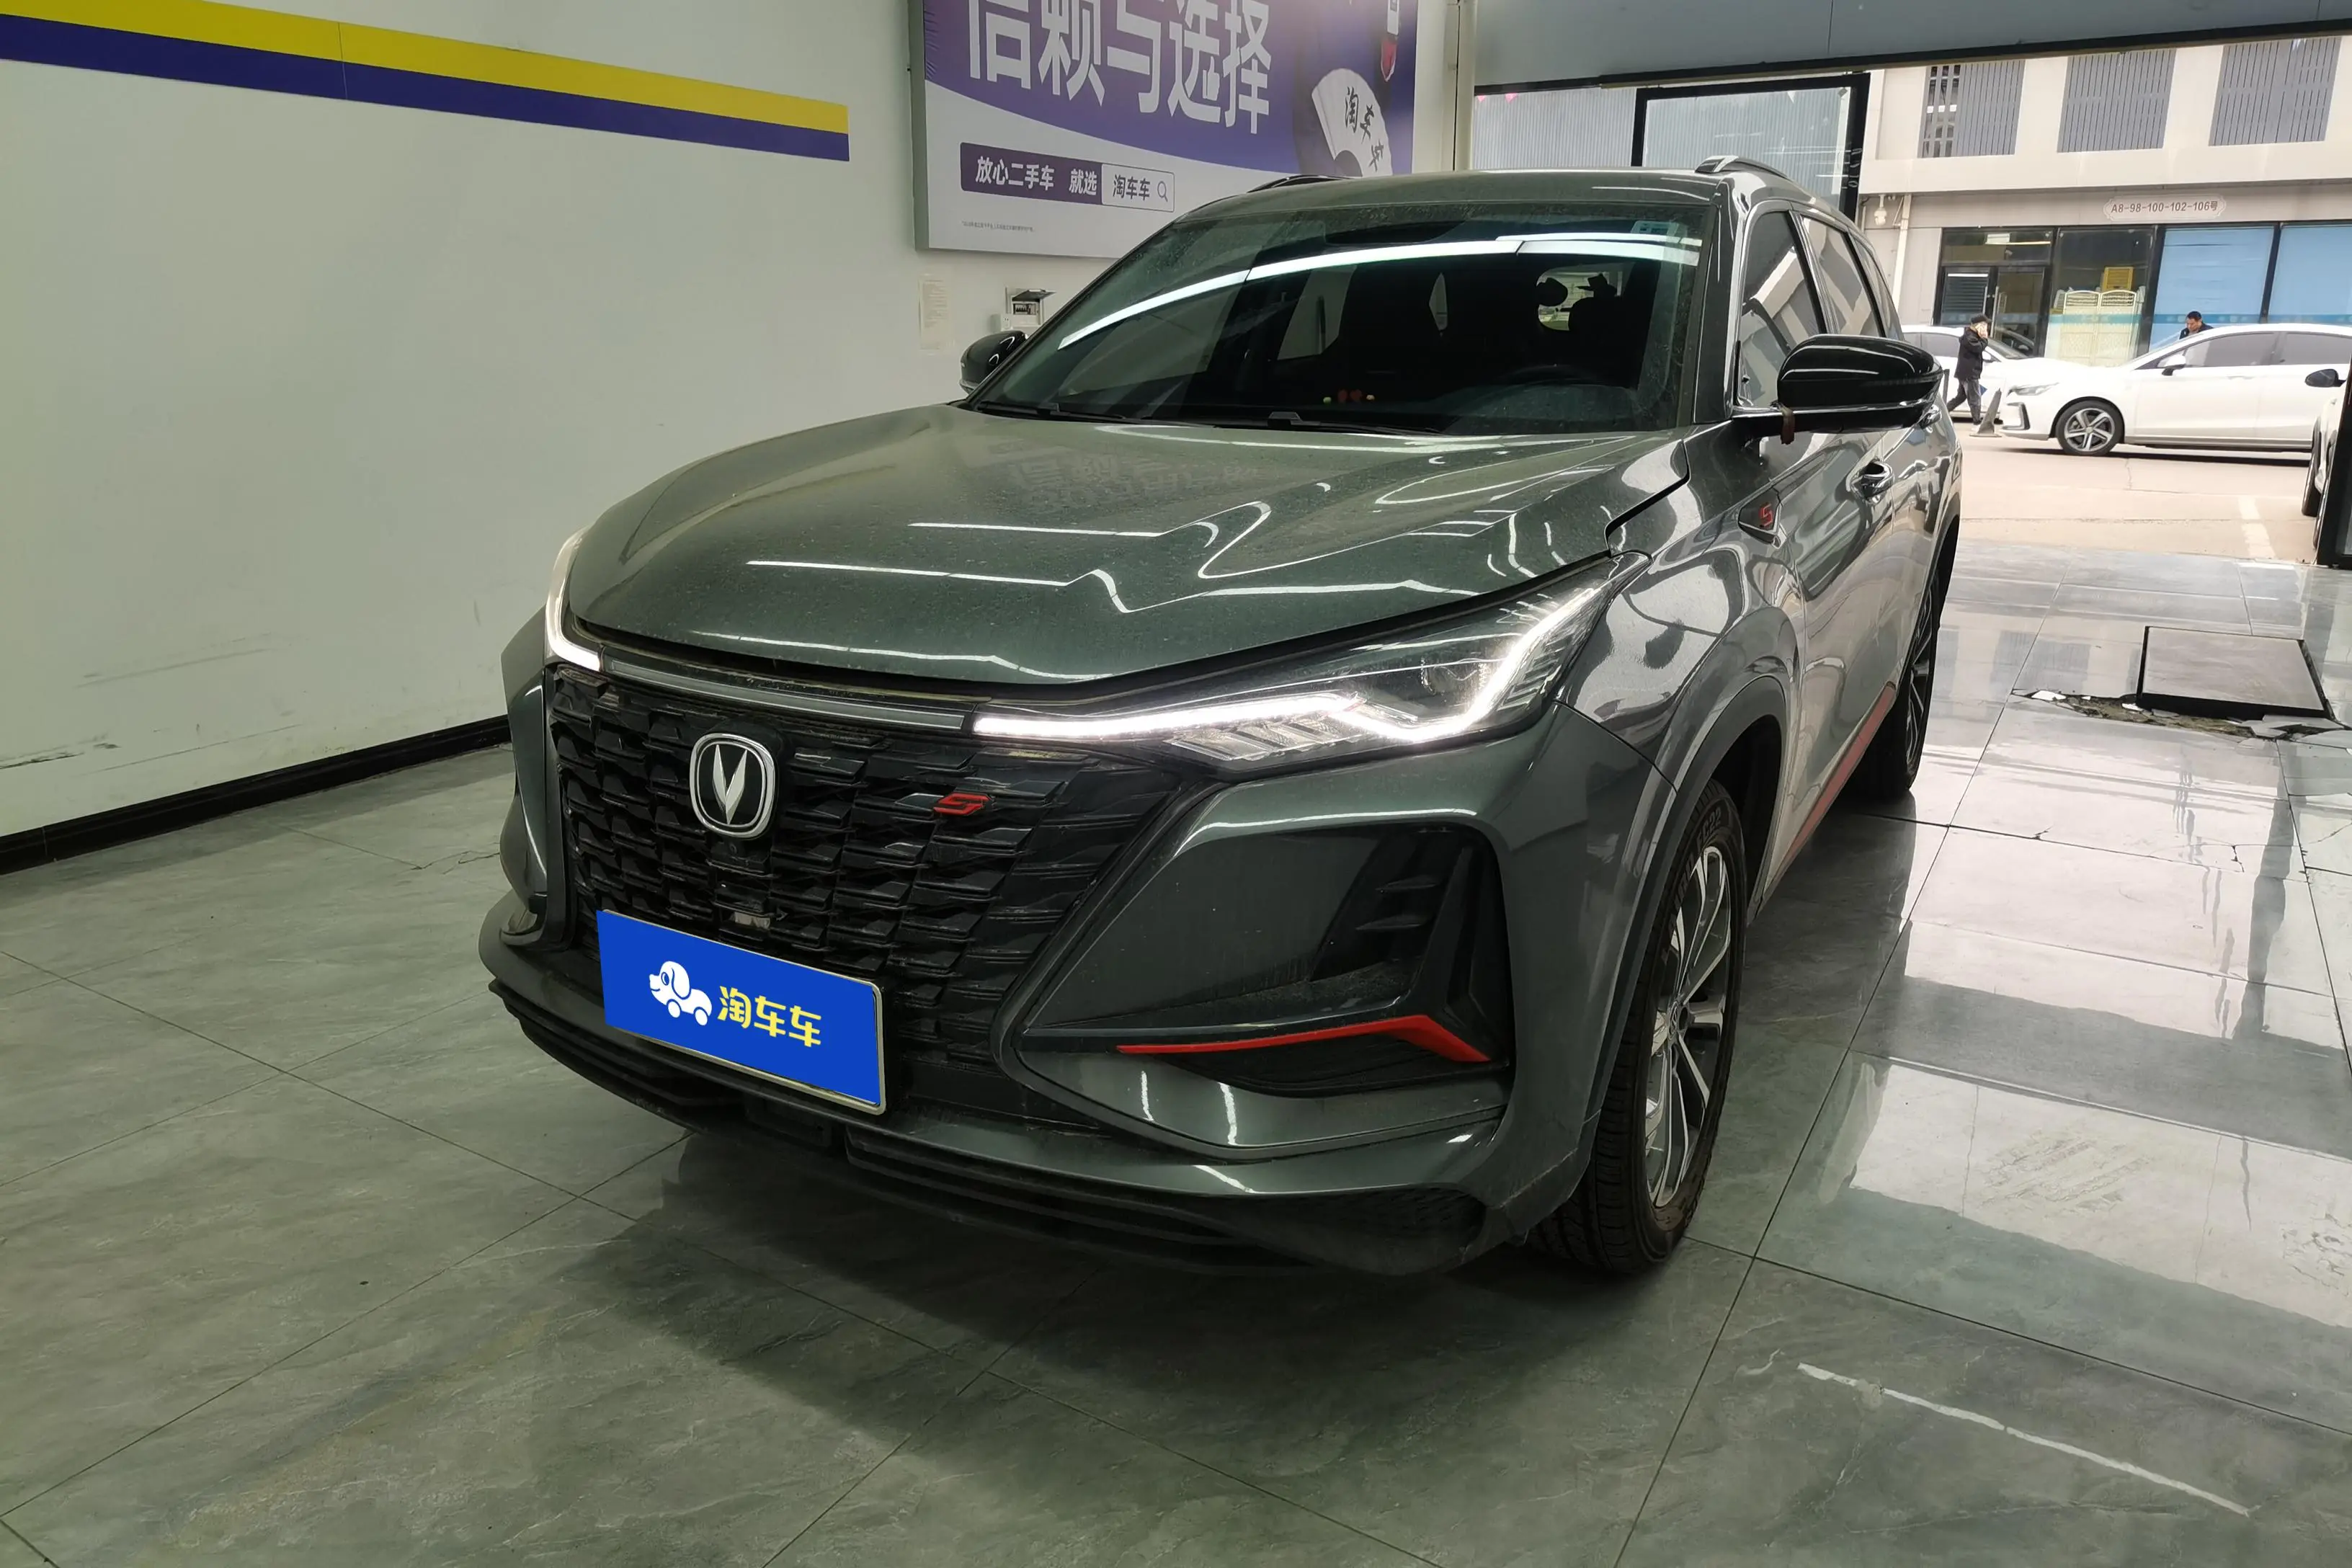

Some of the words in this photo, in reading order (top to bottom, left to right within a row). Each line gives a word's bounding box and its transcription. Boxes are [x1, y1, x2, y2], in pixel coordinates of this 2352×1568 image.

[975, 156, 1055, 191] 放心二手车
[1069, 169, 1097, 195] 就选
[1113, 174, 1151, 201] 淘车车
